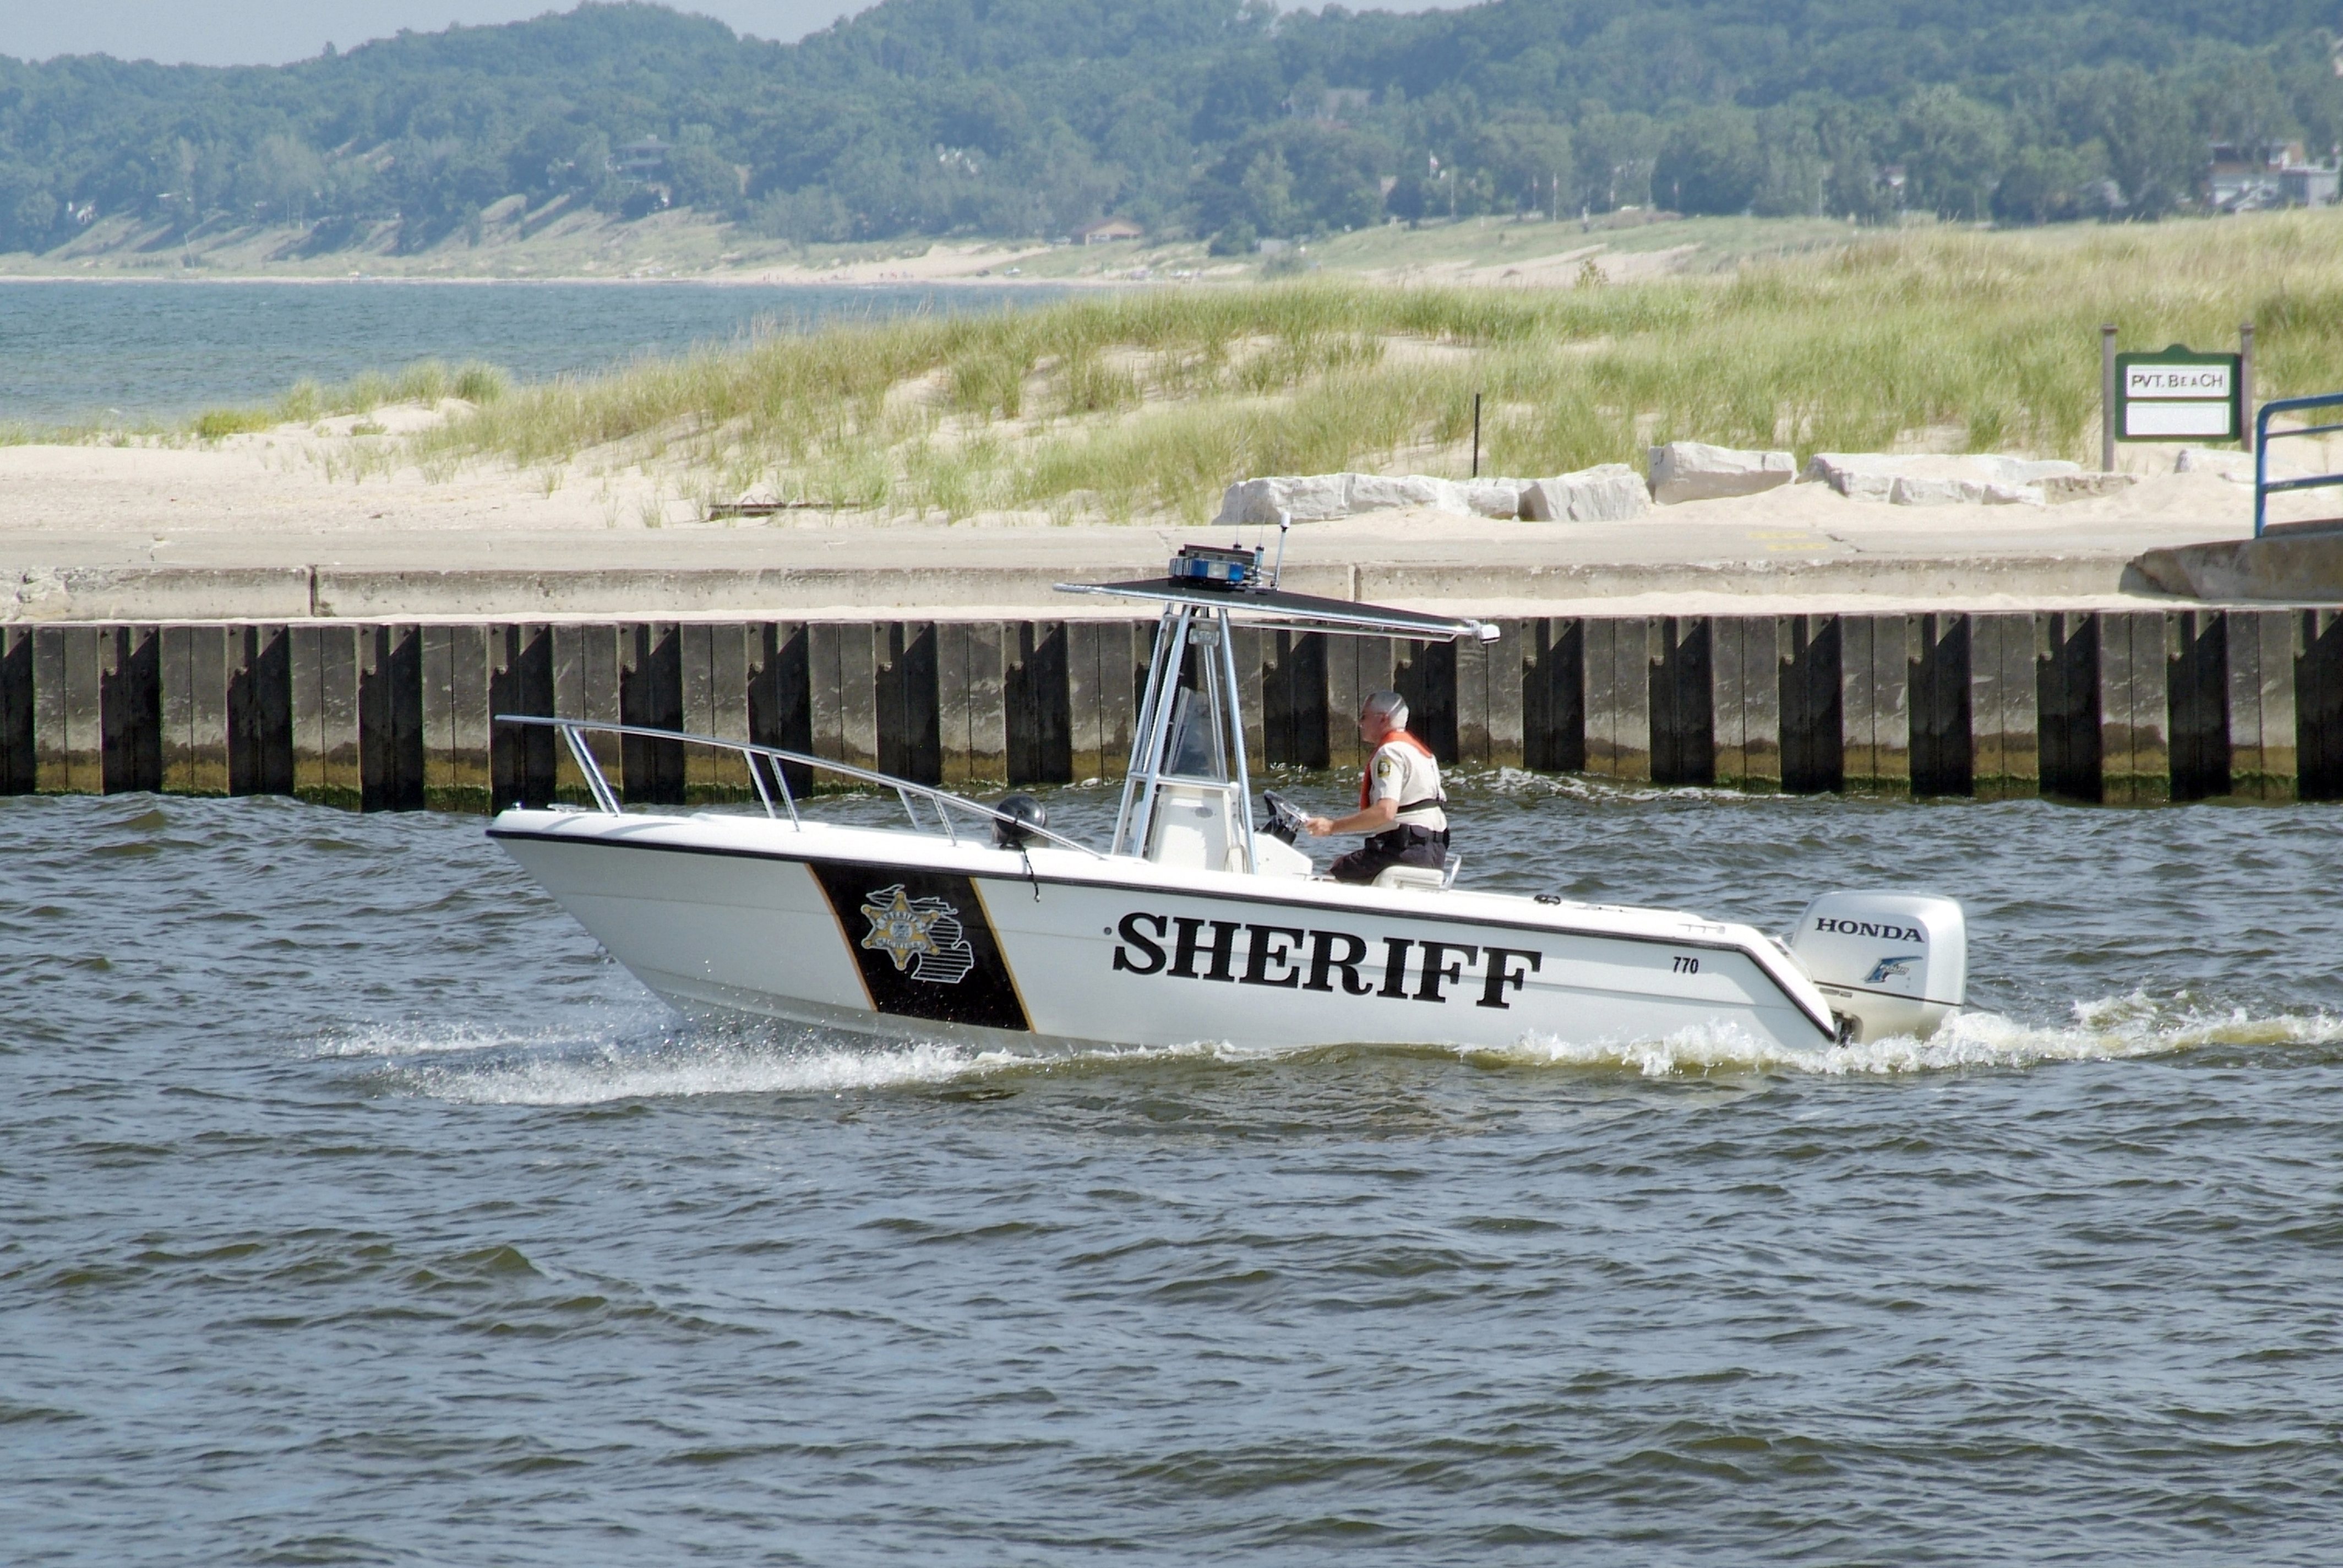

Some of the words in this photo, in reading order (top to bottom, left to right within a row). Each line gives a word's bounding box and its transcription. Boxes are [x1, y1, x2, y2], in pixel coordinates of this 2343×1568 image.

[2131, 374, 2165, 388] PVT.
[2168, 373, 2223, 388] BEACH
[1816, 917, 1925, 943] HONDA
[1113, 912, 1543, 1009] SHERIFF
[1673, 956, 1699, 974] 770
